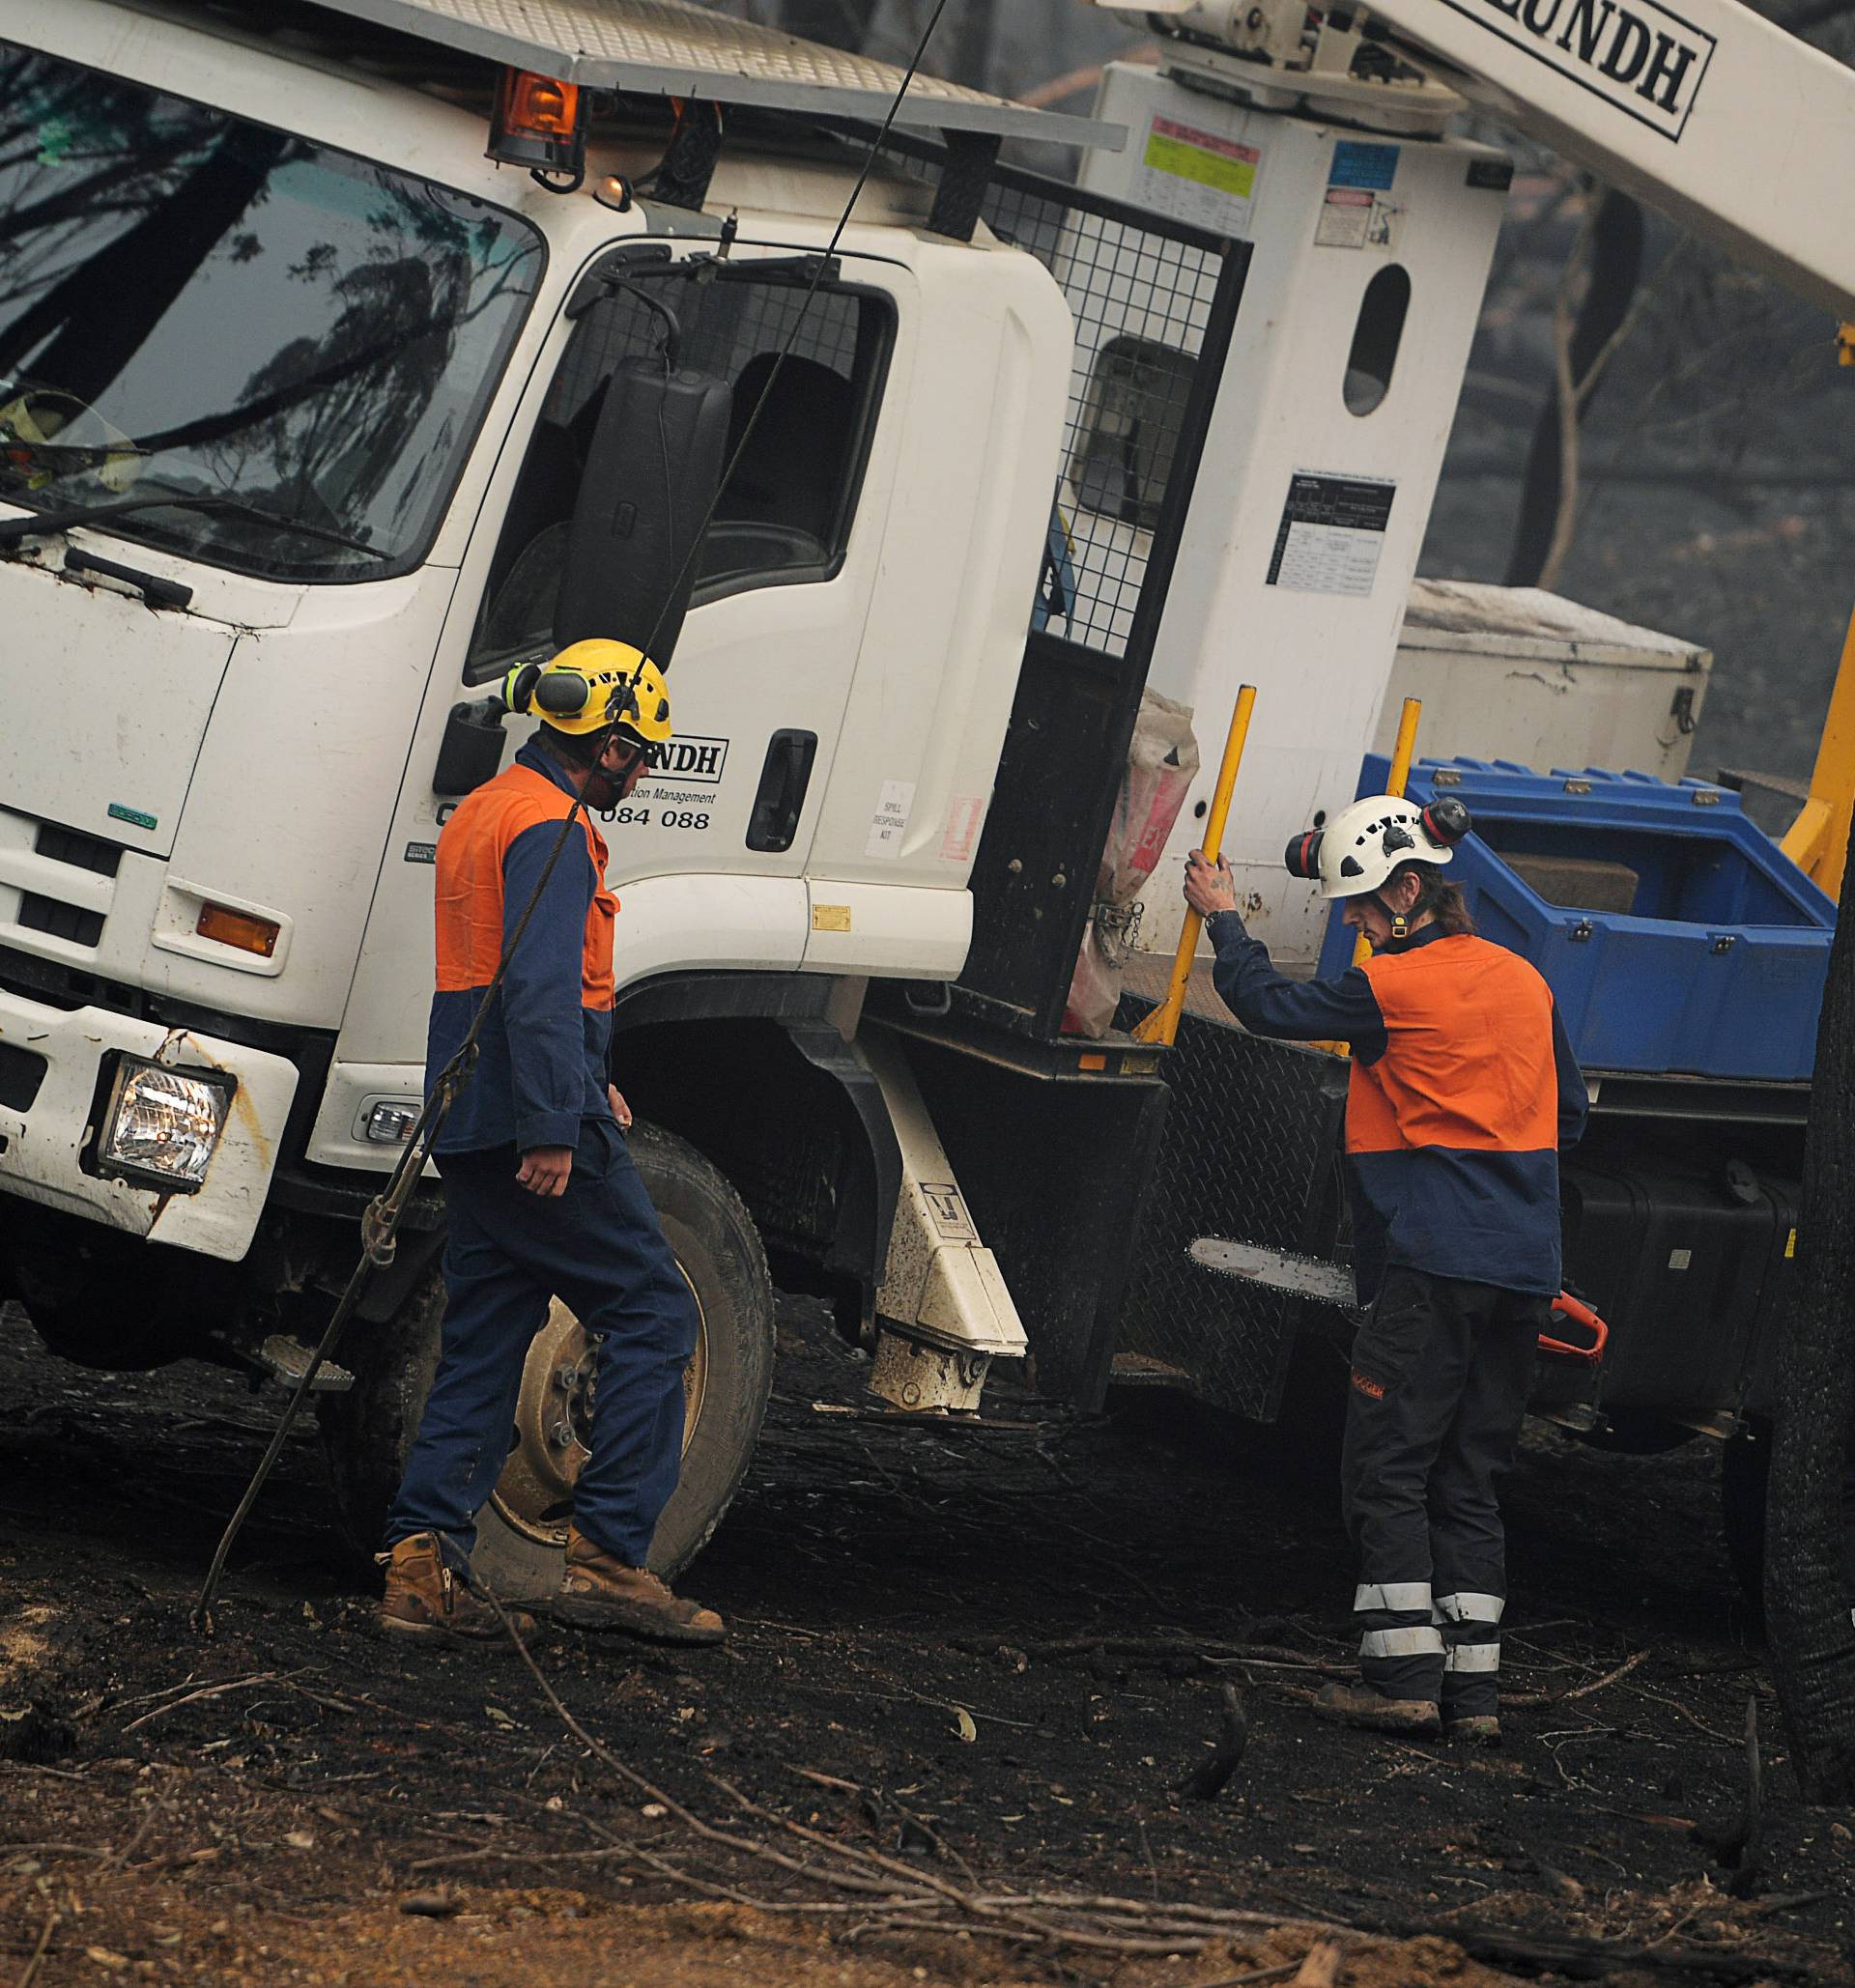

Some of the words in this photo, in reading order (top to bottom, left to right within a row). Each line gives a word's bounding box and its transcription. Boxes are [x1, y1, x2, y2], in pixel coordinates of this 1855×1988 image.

[1483, 0, 1697, 115] UNDH
[650, 742, 721, 774] NDH
[630, 787, 650, 800] tion
[652, 787, 717, 804] Management
[883, 802, 901, 813] SPILL
[600, 808, 650, 825] 084
[661, 810, 710, 830] 088
[873, 814, 905, 828] RESPONSE
[880, 830, 892, 840] KIT
